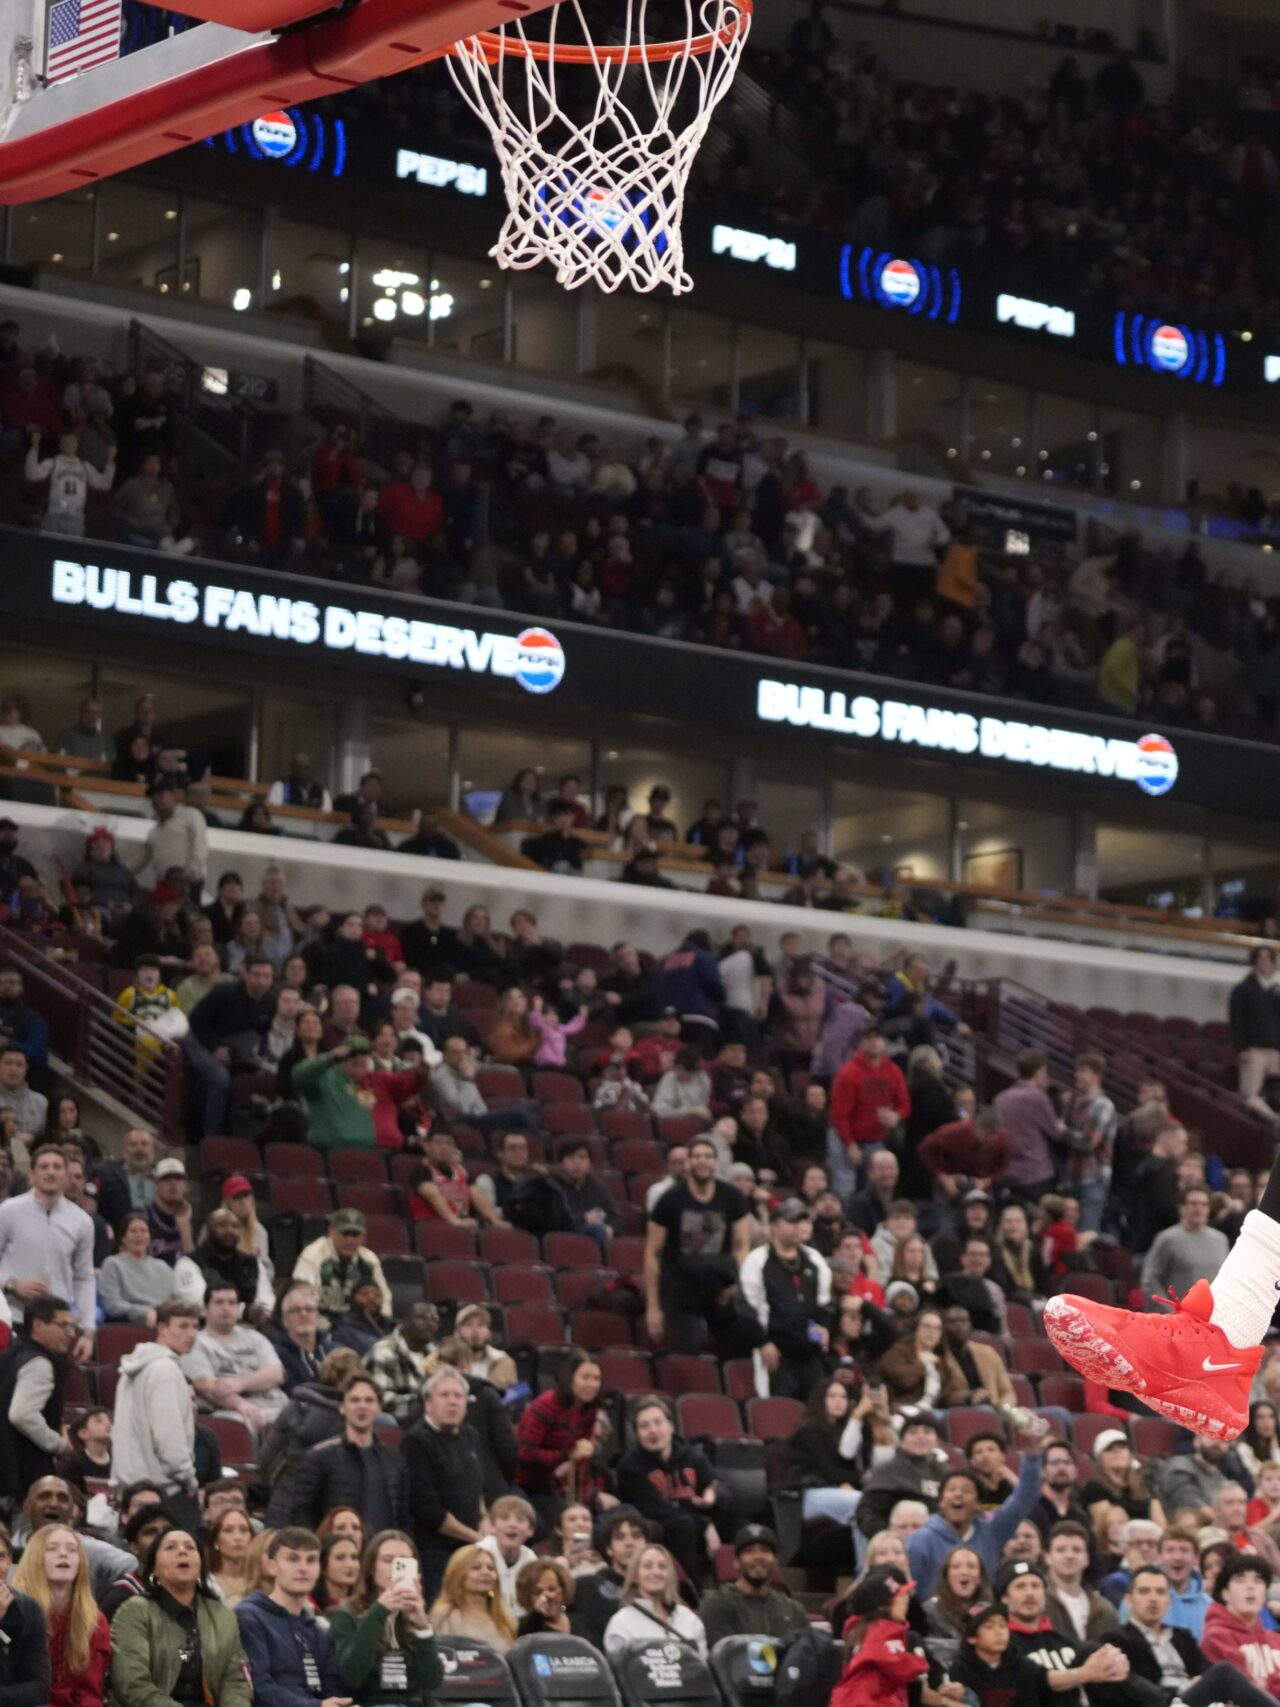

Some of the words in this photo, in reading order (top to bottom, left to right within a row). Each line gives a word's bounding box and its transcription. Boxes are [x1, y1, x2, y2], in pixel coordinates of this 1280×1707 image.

[397, 150, 486, 196] PEPSI
[713, 225, 796, 270] PEPSI
[997, 294, 1074, 336] PEPSI
[53, 560, 200, 623] BULLS
[204, 586, 321, 644] FANS
[325, 606, 518, 678] DESERVE
[758, 679, 881, 737] BULLS
[882, 701, 979, 754] FANS
[979, 717, 1137, 781] DESERVE
